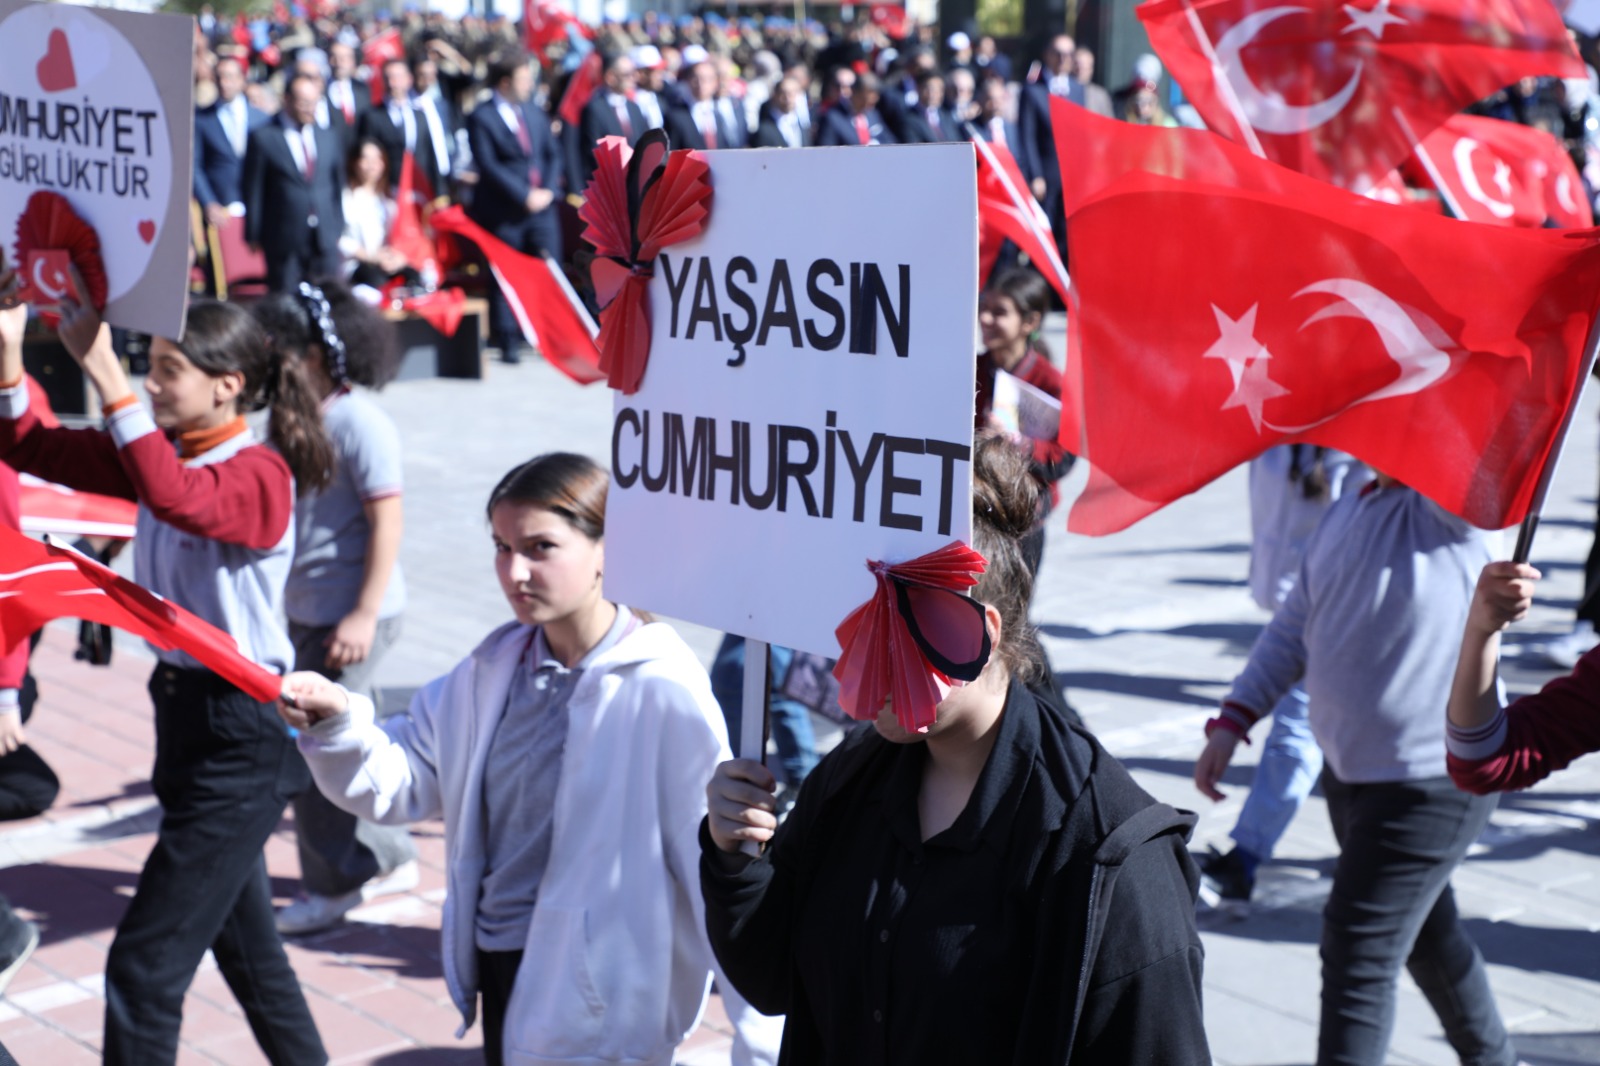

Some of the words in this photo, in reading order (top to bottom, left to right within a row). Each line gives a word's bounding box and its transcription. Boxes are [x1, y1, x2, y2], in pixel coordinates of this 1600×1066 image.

[0, 90, 157, 157] MHURİYET
[659, 253, 910, 367] YAŞASIN
[611, 407, 971, 536] CUMHURİYET
